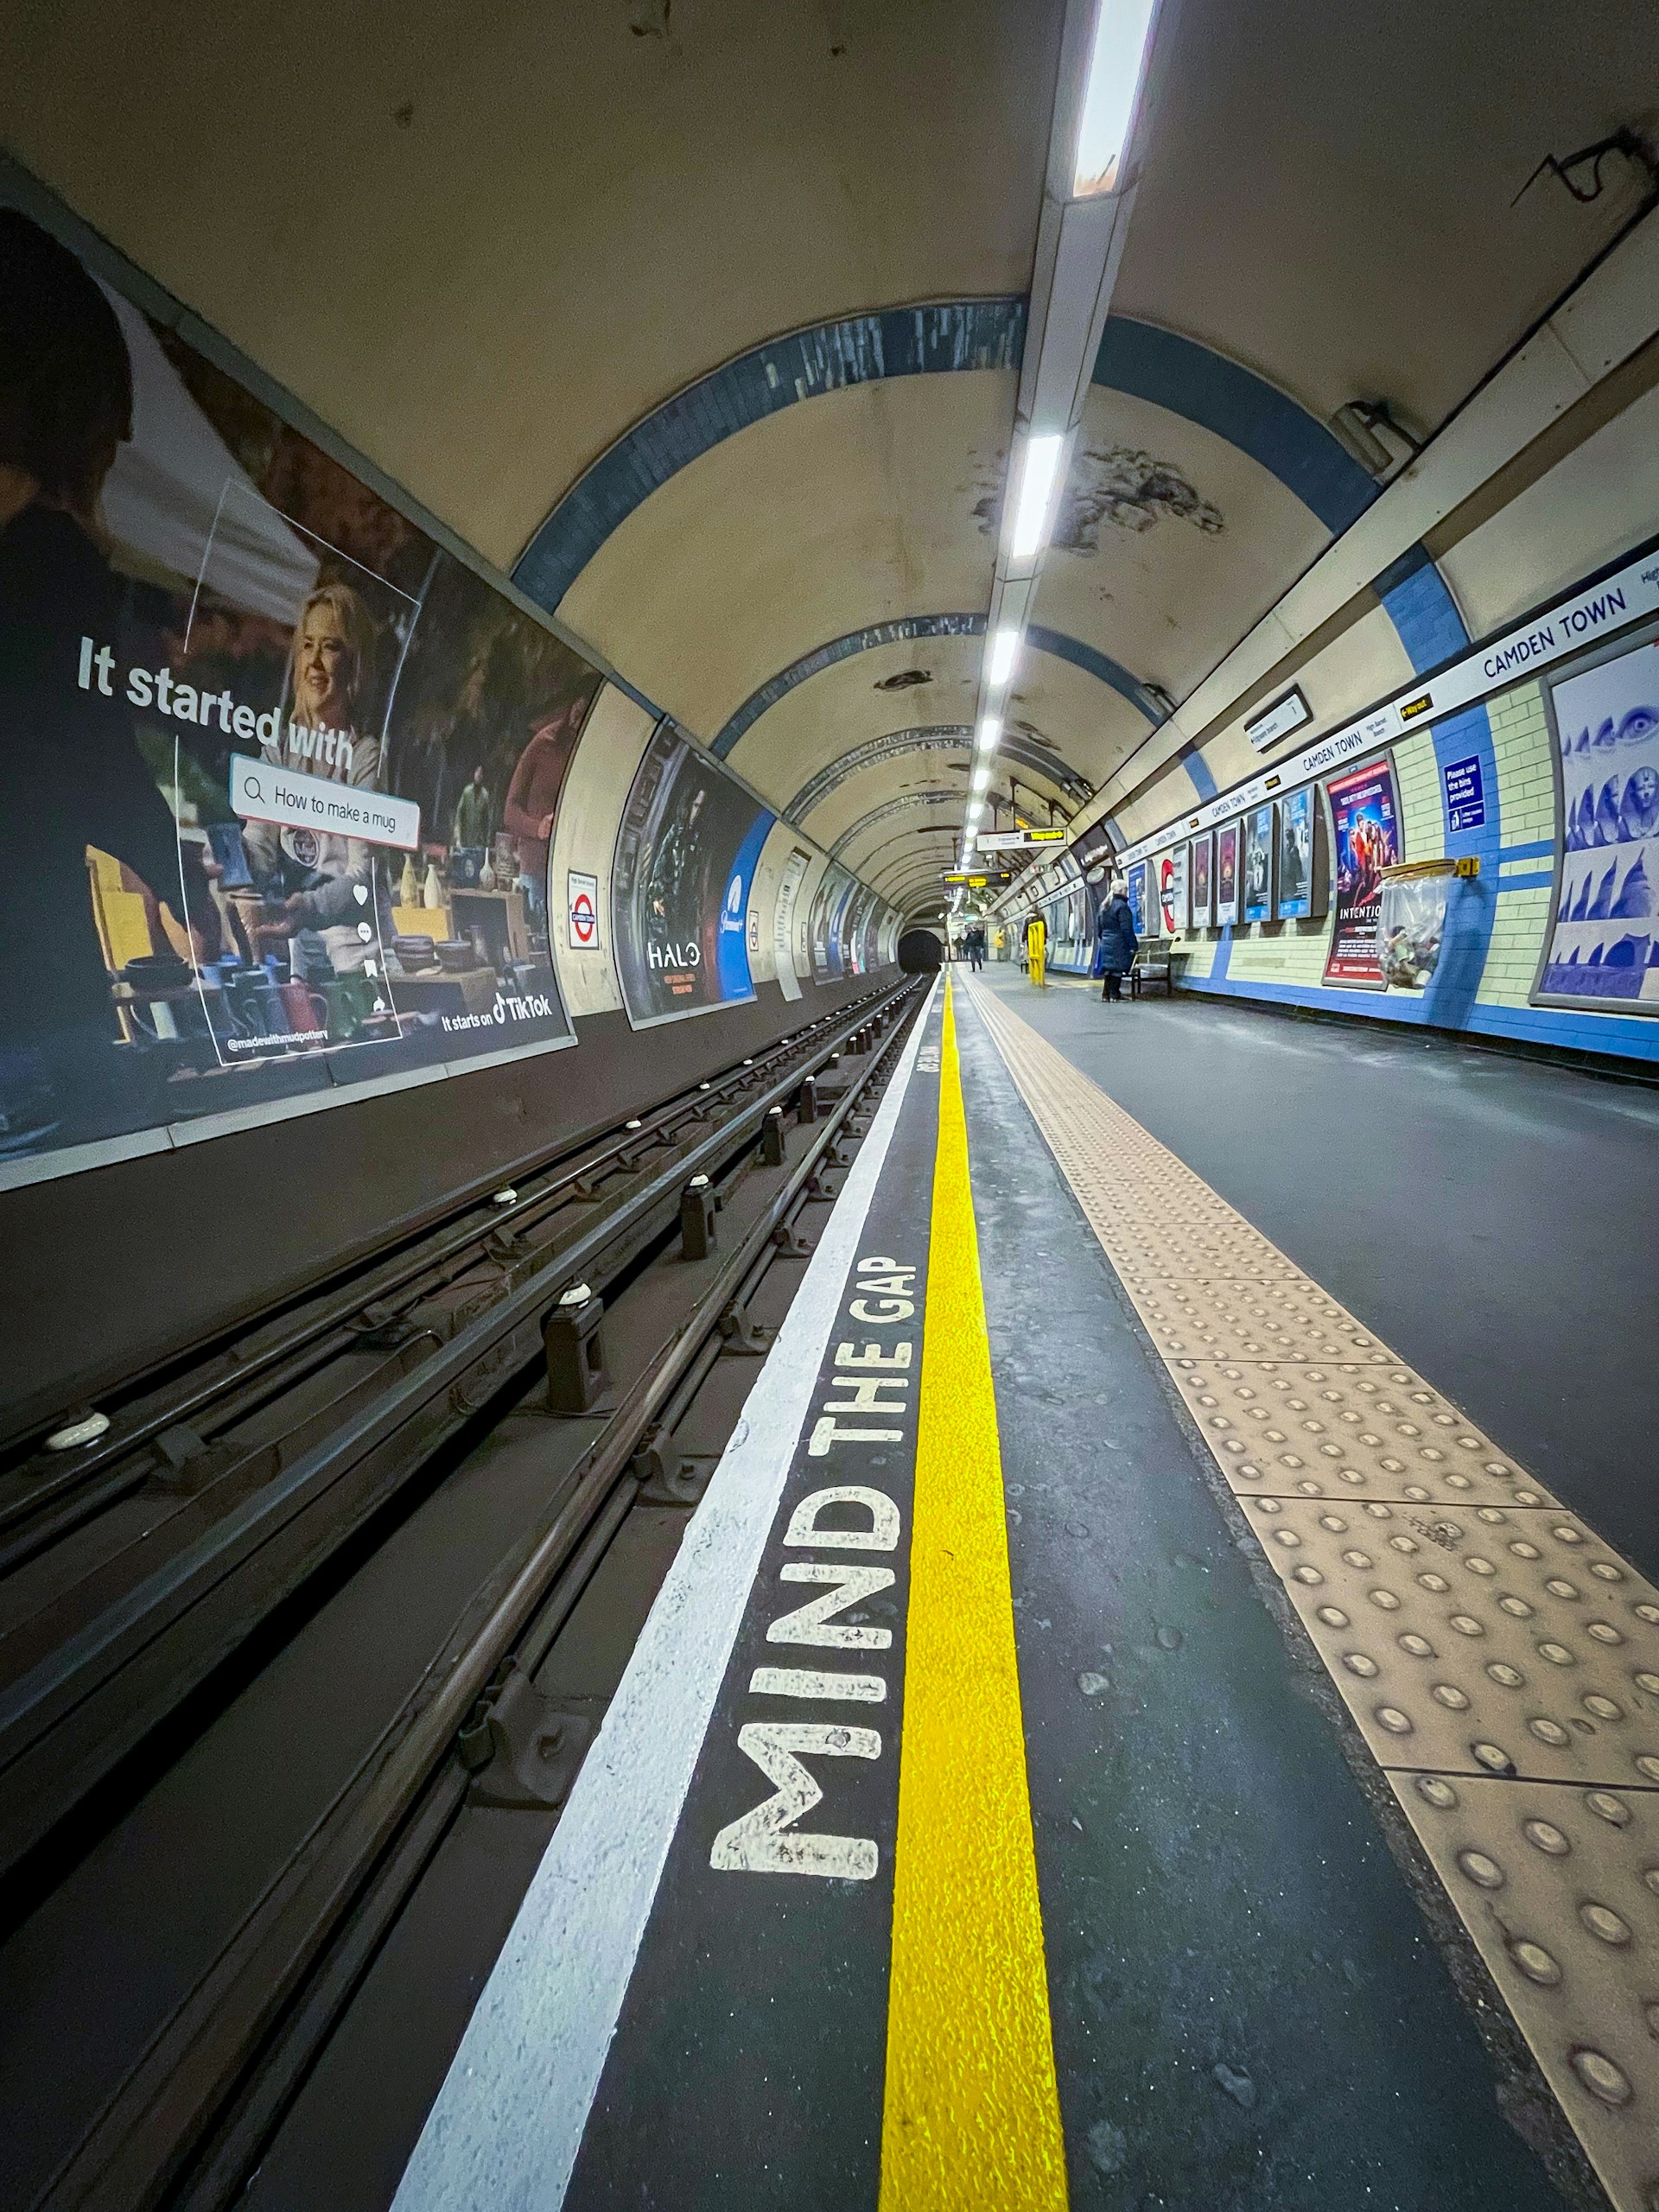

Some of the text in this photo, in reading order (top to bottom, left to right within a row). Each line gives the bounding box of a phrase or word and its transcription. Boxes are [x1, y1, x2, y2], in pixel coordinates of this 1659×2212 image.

[1484, 588, 1626, 678] CAMDEN TOWN
[78, 636, 353, 771] It started with
[1303, 730, 1363, 771] CAMDEN TOWN
[1447, 764, 1477, 781] Please use
[1448, 778, 1471, 791] the bins
[275, 785, 396, 834] How to make a mug
[1450, 786, 1475, 804] provided
[1339, 905, 1382, 920] INTENTIO
[647, 942, 701, 969] HALO
[442, 994, 553, 1032] It starts on TikTok
[227, 1029, 328, 1052] @madewithmudpottery
[709, 1255, 918, 1880] MIND THE GAP
